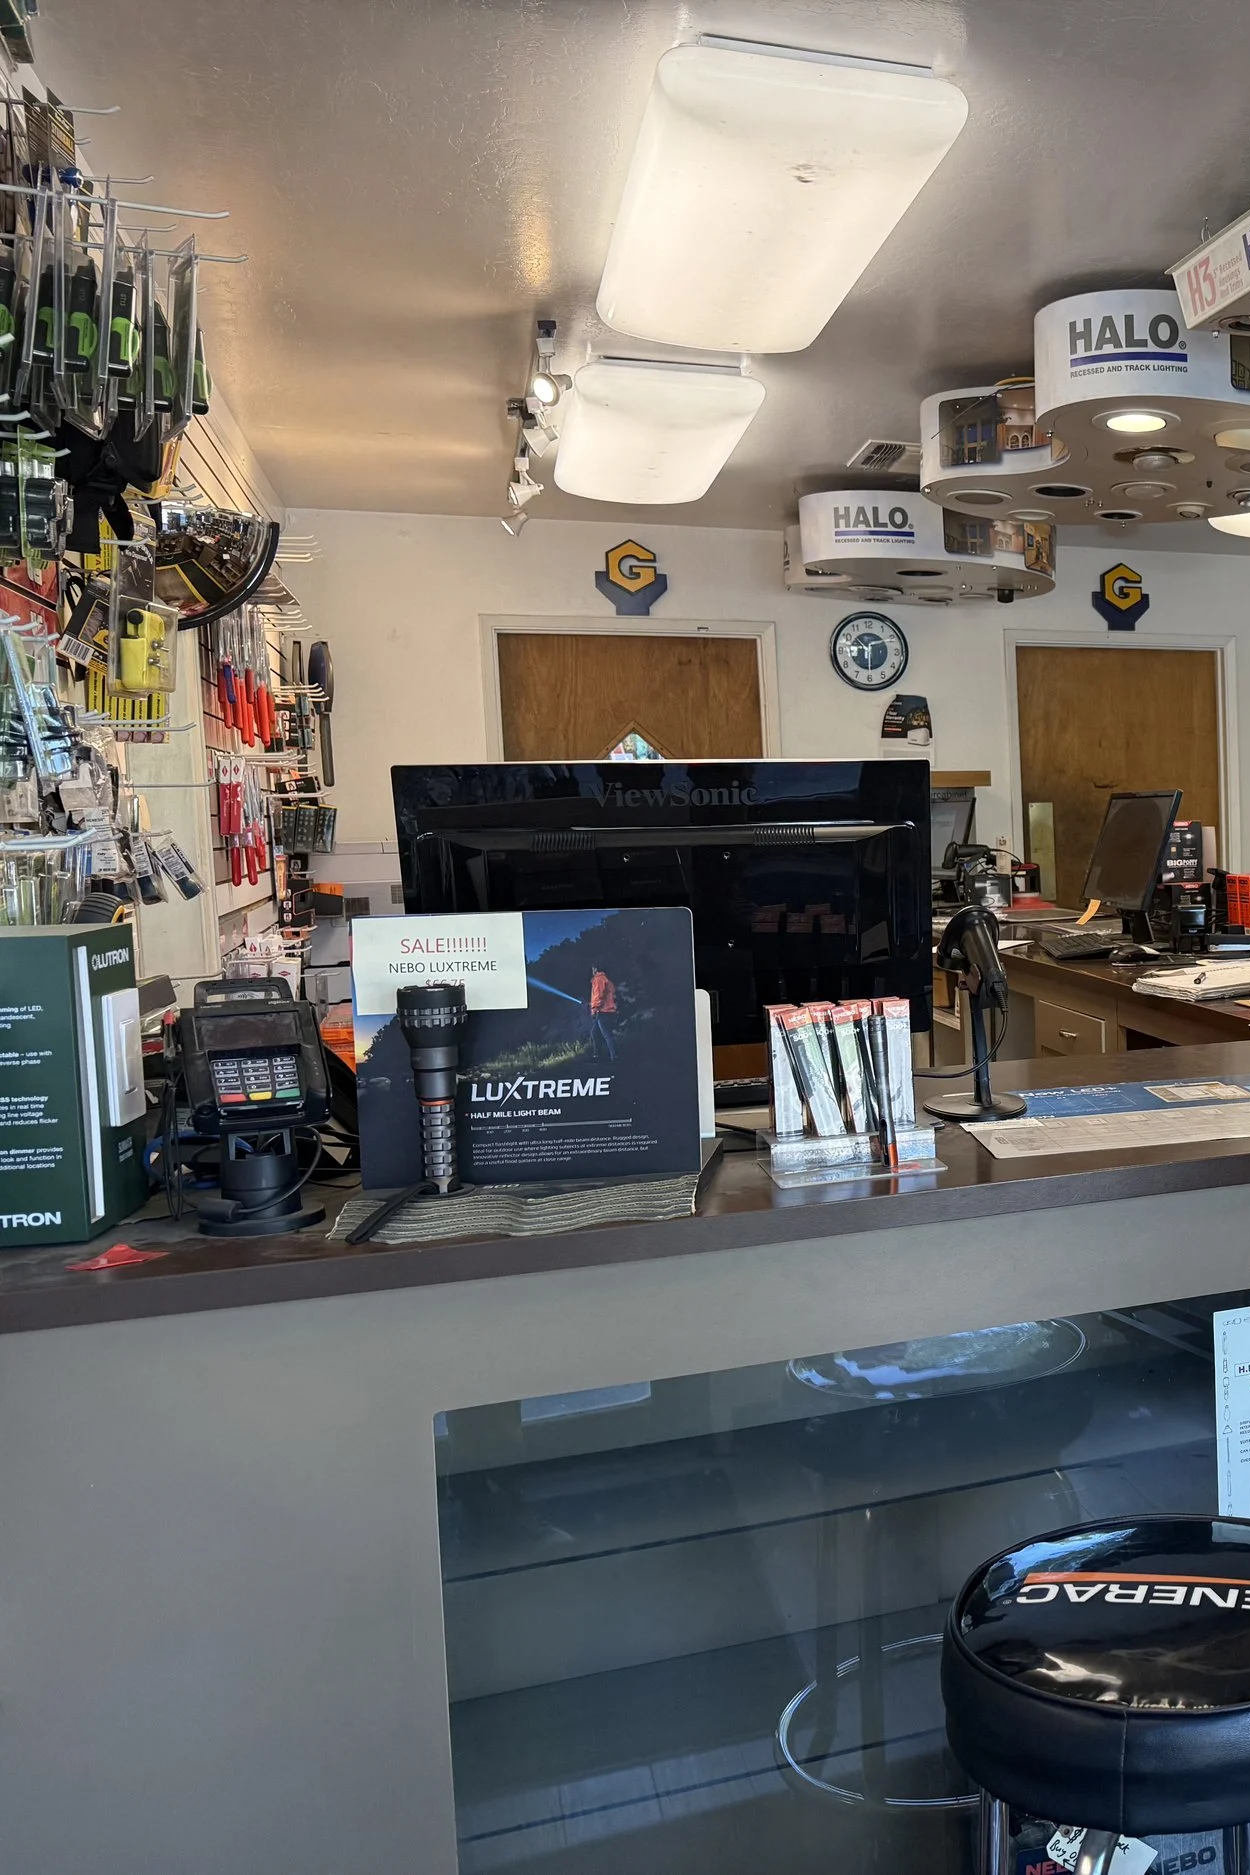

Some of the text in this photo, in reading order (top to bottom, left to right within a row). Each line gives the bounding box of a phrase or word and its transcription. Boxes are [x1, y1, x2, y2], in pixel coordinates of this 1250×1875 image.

[1187, 256, 1217, 317] H3
[1069, 314, 1180, 356] HALO
[1070, 364, 1188, 378] RECESSED AND TRACK LIGHTING
[833, 506, 909, 529] HALO
[605, 539, 657, 596] G
[1100, 562, 1142, 612] G
[851, 624, 860, 632] 11
[864, 620, 873, 629] 12
[894, 648, 900, 657] 3
[854, 671, 860, 679] 7
[867, 675, 873, 683] 6
[880, 671, 886, 680] 5
[586, 781, 758, 807] ViewSonic
[400, 936, 487, 954] SALE!!!!!!!
[98, 948, 129, 969] LUTRON
[389, 960, 497, 974] NEBO LUXTREME
[28, 1004, 43, 1012] LED,
[470, 1073, 612, 1107] LUXTREME
[11, 1095, 49, 1104] technology
[19, 1111, 43, 1119] voltage
[470, 1108, 561, 1120] HALF MILE LIGHT BEAM
[39, 1117, 59, 1125] flicker
[36, 1146, 64, 1154] provides
[29, 1154, 54, 1162] function
[26, 1161, 55, 1169] locations
[0, 1210, 62, 1228] TRON
[1049, 1840, 1066, 1858] Buy
